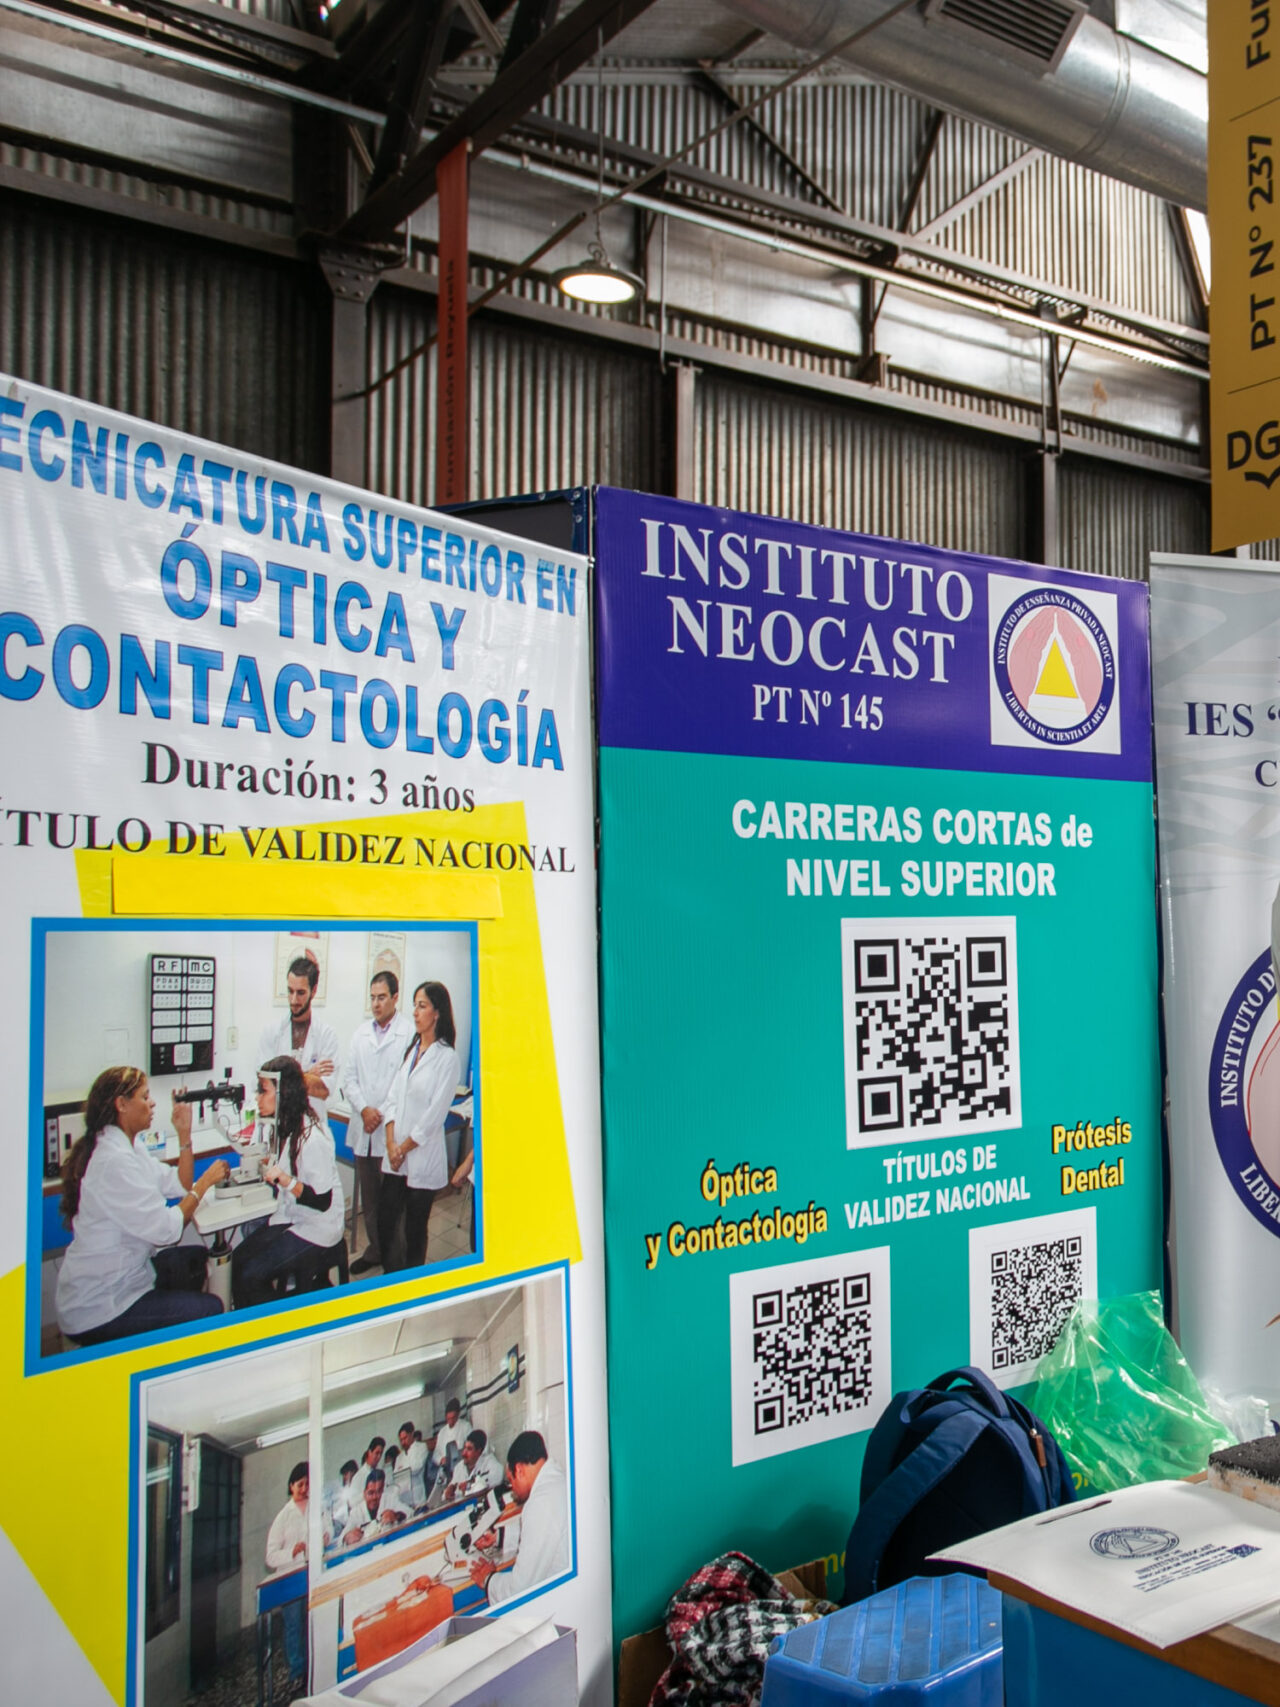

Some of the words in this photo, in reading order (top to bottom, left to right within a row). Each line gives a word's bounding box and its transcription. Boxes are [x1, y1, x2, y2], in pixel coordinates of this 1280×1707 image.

[1246, 0, 1271, 69] Fu
[1247, 135, 1274, 212] 237
[1250, 294, 1276, 350] PT
[0, 396, 330, 553] ECNICATURA
[343, 503, 526, 604] SUPERIOR
[537, 558, 577, 616] EN
[161, 523, 416, 663] ÓPTICA
[432, 602, 466, 670] Y
[641, 519, 973, 622] INSTITUTO
[667, 596, 955, 683] NEOCAST
[997, 614, 1017, 664] INSTITUTO
[1014, 603, 1027, 616] DE
[1024, 592, 1071, 609] ENSEÑANZA
[1071, 601, 1100, 635] PRIVADA
[1097, 633, 1113, 679] NEOCAST
[0, 612, 564, 771] CONTACTOLOGÍA
[753, 684, 792, 723] PT
[800, 690, 832, 724] Nº
[840, 694, 884, 731] 145
[1005, 691, 1037, 731] LIBERTAS
[1036, 725, 1047, 737] IN
[1047, 729, 1083, 741] SCIENTIA
[1081, 722, 1093, 734] ET
[1091, 703, 1107, 727] ARTE
[1184, 701, 1254, 738] IES
[142, 741, 355, 802] Duración:
[369, 769, 389, 805] 3
[403, 775, 476, 813] años
[0, 800, 151, 853] TULO
[166, 820, 226, 857] DE
[240, 826, 405, 865] VALIDEZ
[415, 837, 576, 873] NACIONAL
[732, 799, 922, 844] CARRERAS
[932, 808, 1053, 846] CORTAS
[1061, 815, 1094, 848] de
[786, 859, 891, 896] NIVEL
[901, 860, 1057, 896] SUPERIOR
[1221, 988, 1264, 1107] INSTITUTO
[883, 1147, 967, 1186] TÍTULOS
[973, 1144, 997, 1171] DE
[1051, 1116, 1133, 1156] Prótesis
[700, 1159, 778, 1208] Óptica
[844, 1190, 930, 1230] VALIDEZ
[936, 1175, 1031, 1215] NACIONAL
[1061, 1157, 1125, 1197] Dental
[645, 1231, 662, 1270] y
[668, 1201, 829, 1257] Contactología
